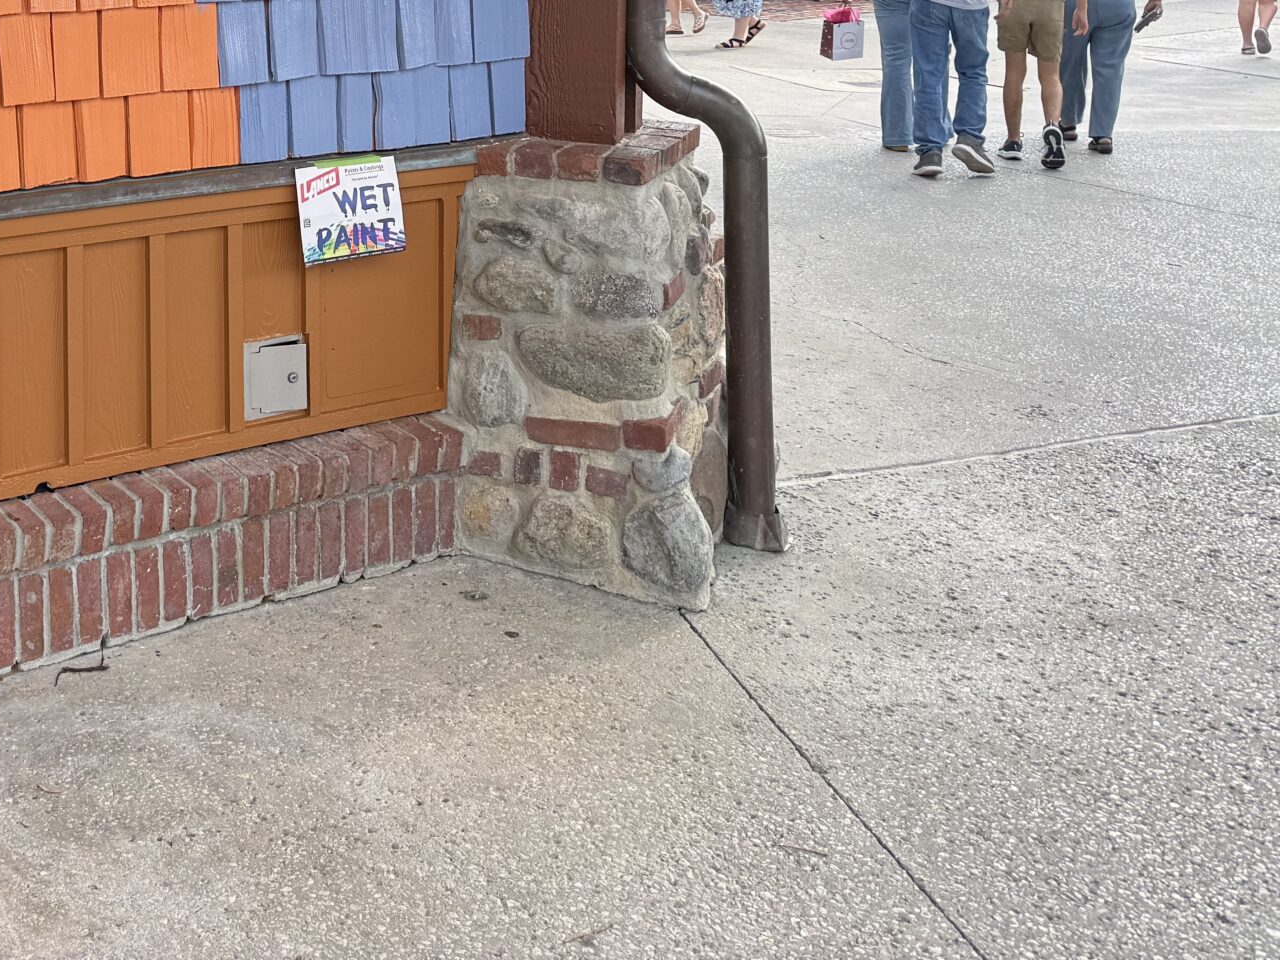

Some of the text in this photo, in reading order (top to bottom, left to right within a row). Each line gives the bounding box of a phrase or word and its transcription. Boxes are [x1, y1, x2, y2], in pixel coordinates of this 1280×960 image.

[302, 170, 338, 201] LANCO
[332, 183, 395, 218] WET
[316, 217, 396, 254] PAINT
